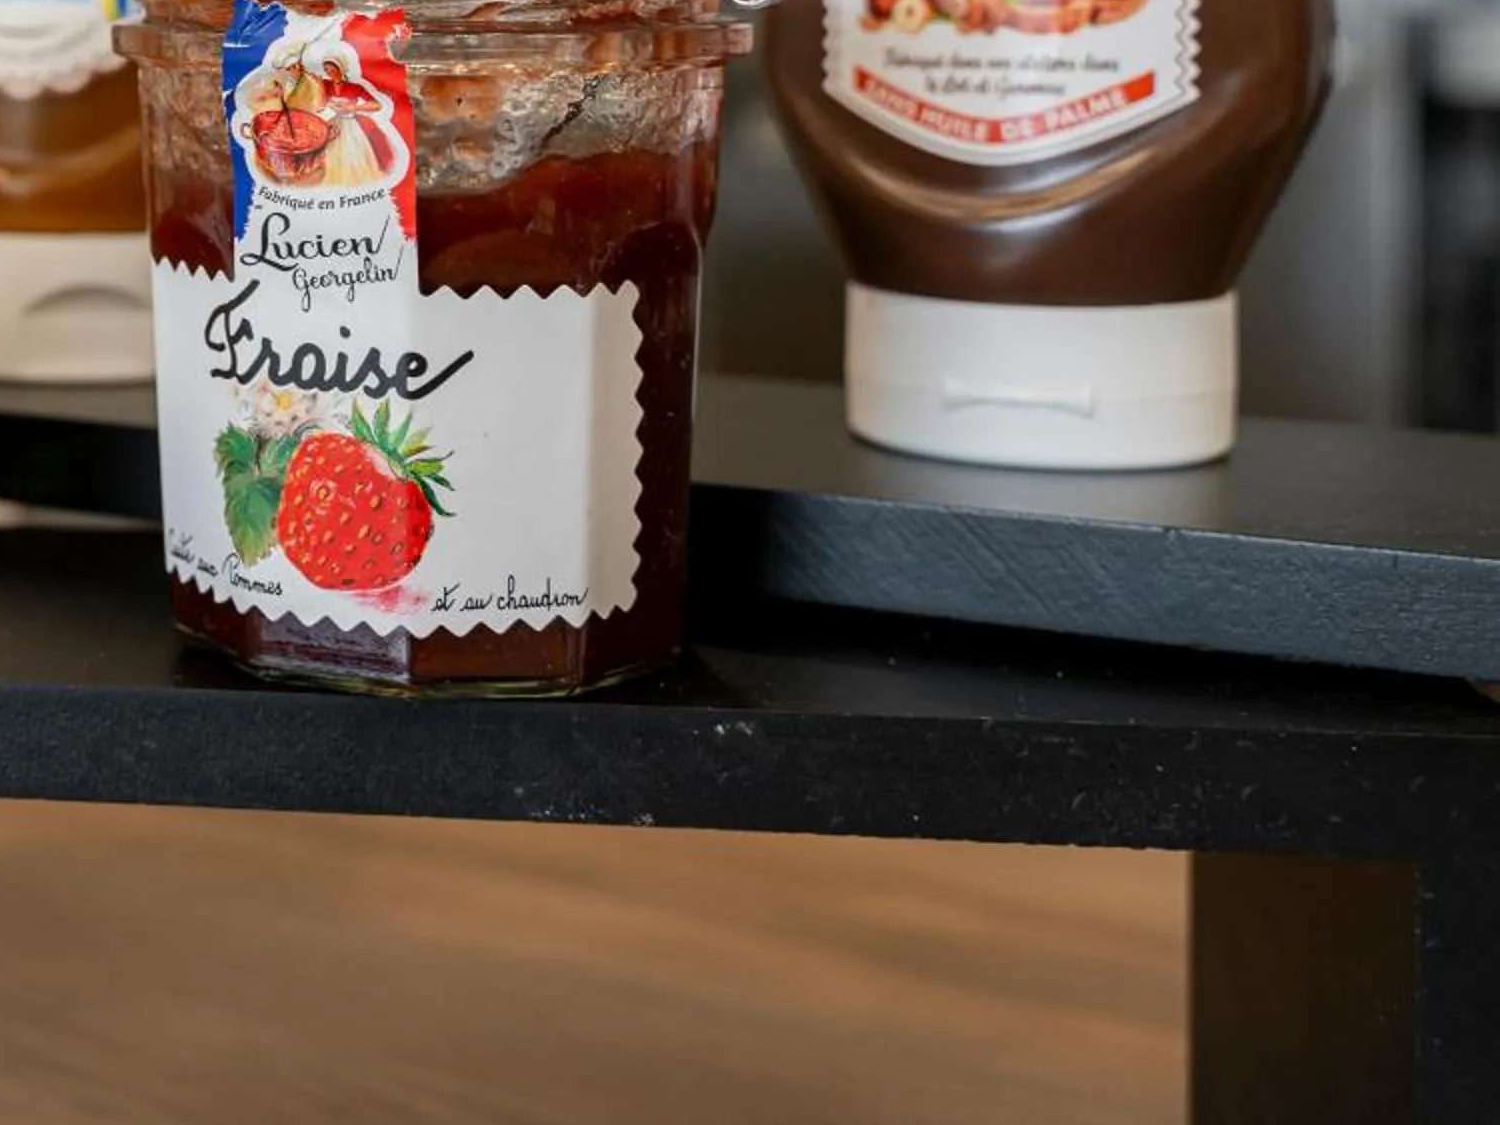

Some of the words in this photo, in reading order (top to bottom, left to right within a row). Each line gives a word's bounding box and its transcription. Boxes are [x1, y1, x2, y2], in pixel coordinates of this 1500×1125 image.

[1001, 119, 1035, 141] DE
[1044, 87, 1125, 132] PALME
[317, 198, 336, 211] en
[338, 187, 386, 209] France
[238, 211, 391, 272] Lucien
[291, 245, 404, 313] Georgelin
[204, 279, 475, 401] Fraise
[431, 583, 461, 612] et
[459, 593, 493, 612] au
[496, 574, 590, 612] chaudron
